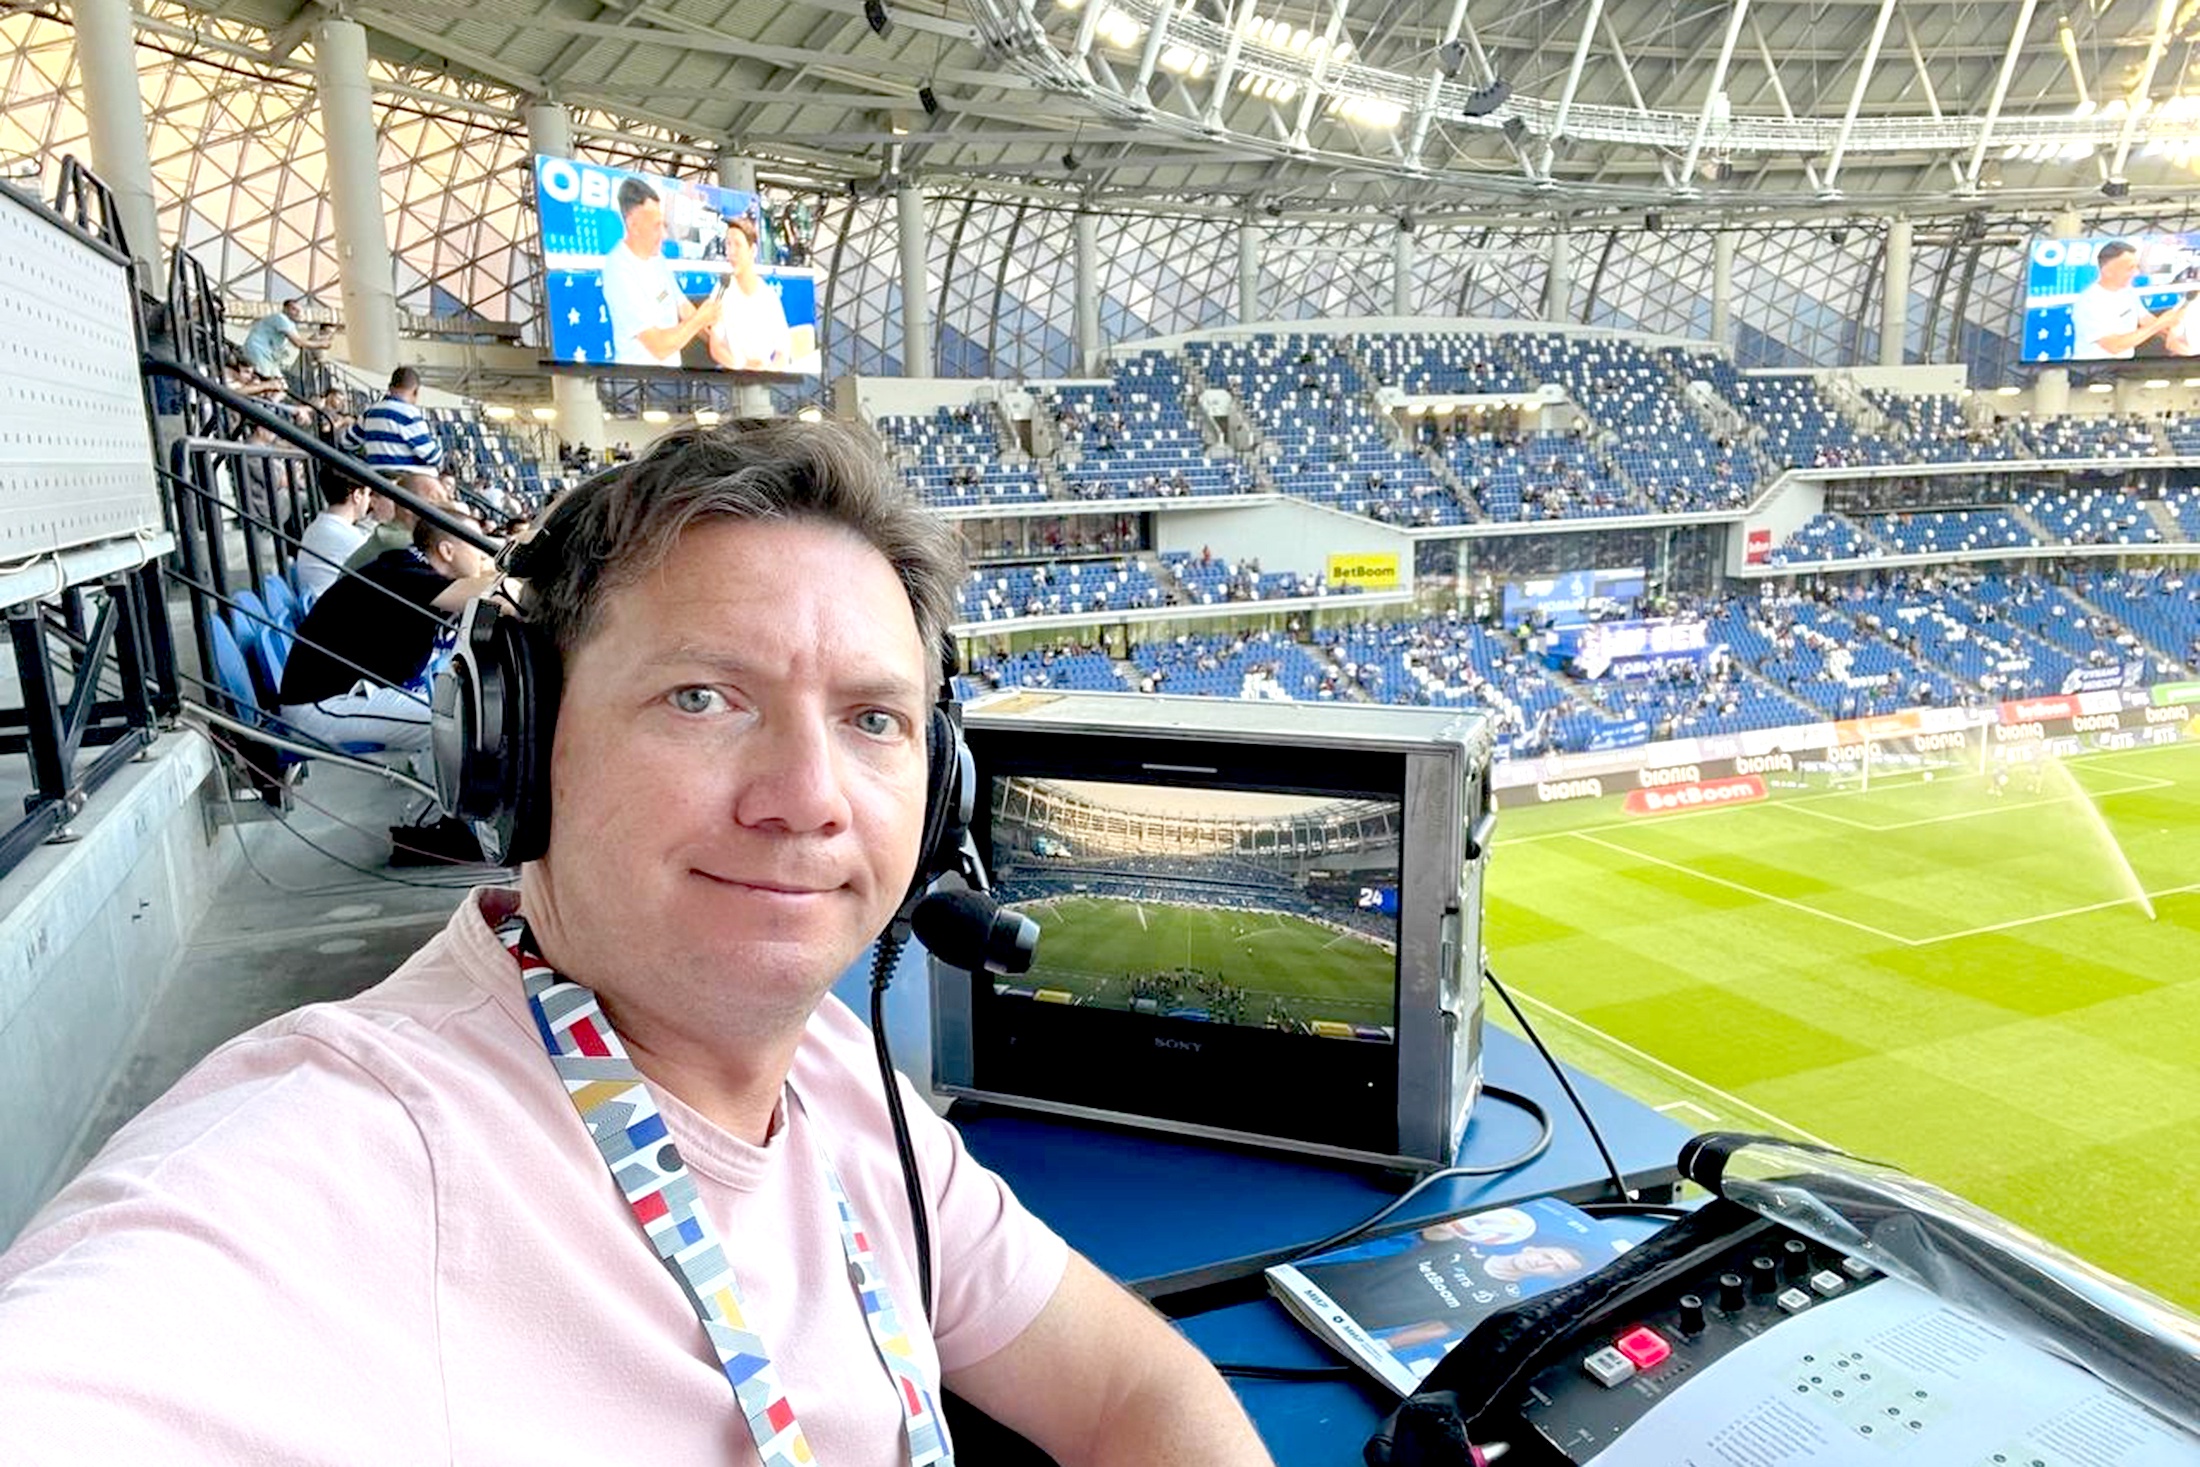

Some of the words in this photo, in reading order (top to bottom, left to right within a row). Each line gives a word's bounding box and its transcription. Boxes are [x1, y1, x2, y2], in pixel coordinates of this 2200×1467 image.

[1333, 566, 1395, 578] BetBoom
[2072, 714, 2119, 732] bioniq
[2145, 705, 2189, 723] bioniq
[1914, 731, 1966, 752] bioniq
[1995, 722, 2044, 741] bioniq
[1827, 743, 1882, 763] bionq
[1736, 752, 1793, 775] bioniq
[1639, 765, 1700, 787] bioniq
[1538, 778, 1602, 802] bioniq
[1645, 782, 1754, 809] BetBoom
[1359, 887, 1383, 907] 24
[1155, 1037, 1202, 1052] SONY
